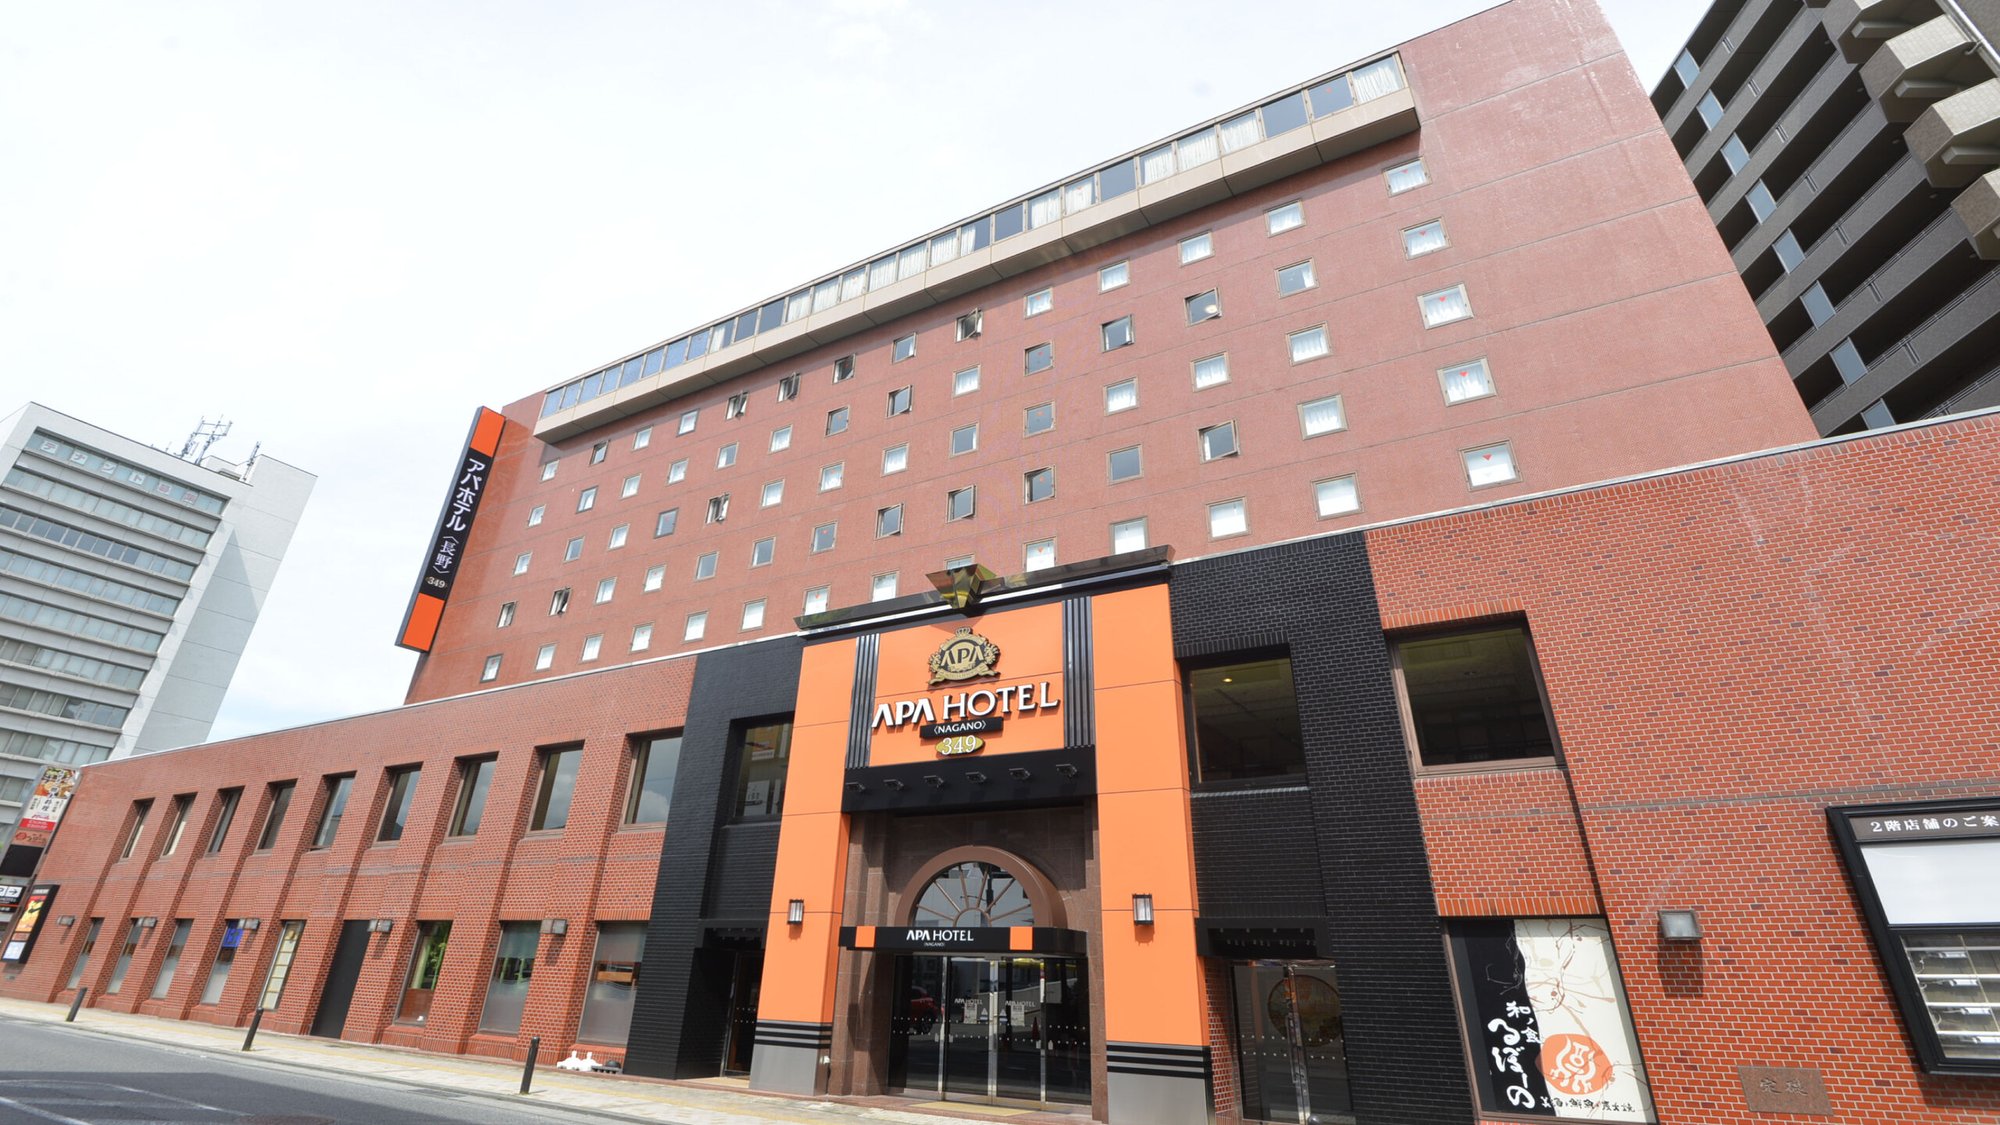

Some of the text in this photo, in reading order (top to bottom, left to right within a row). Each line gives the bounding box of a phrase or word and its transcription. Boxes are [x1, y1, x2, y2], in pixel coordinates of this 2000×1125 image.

[427, 576, 446, 589] 349
[940, 645, 984, 667] APA
[871, 682, 1059, 728] APA HOTEL
[941, 735, 977, 756] 349
[906, 930, 974, 941] APA HOTEL
